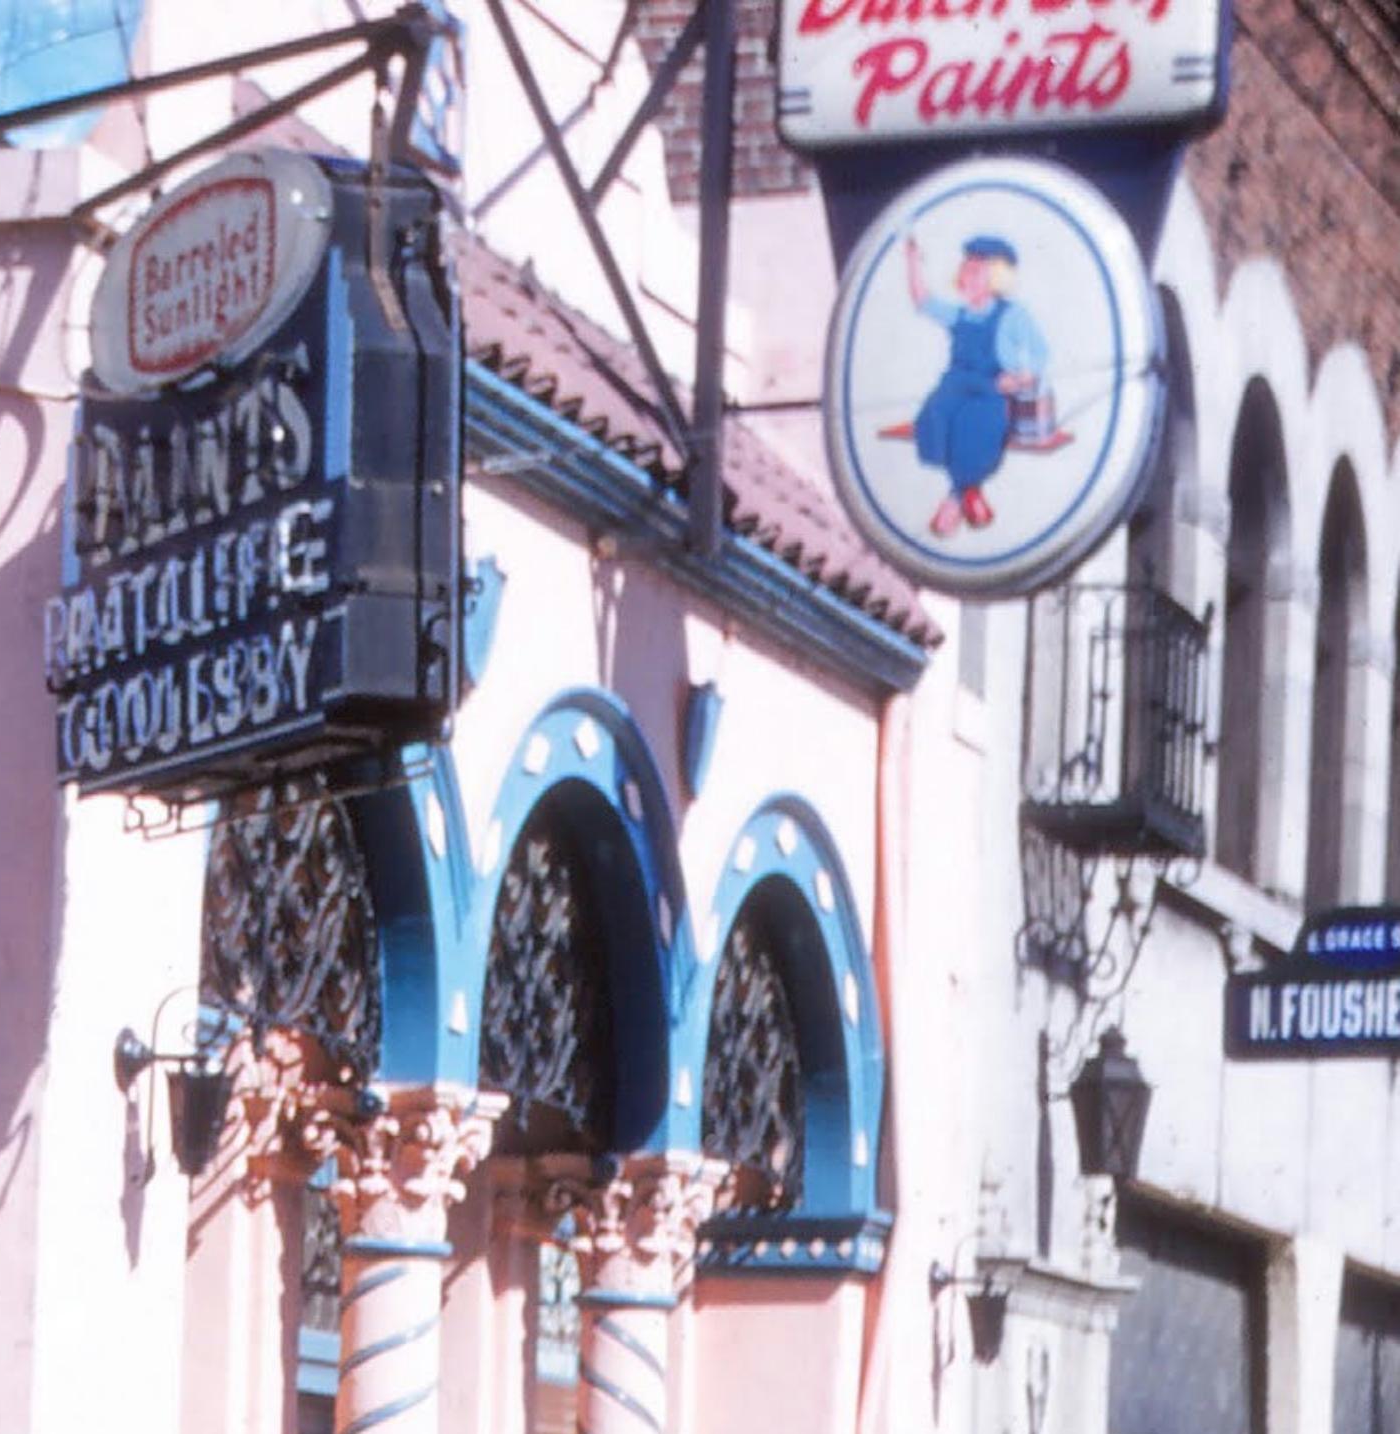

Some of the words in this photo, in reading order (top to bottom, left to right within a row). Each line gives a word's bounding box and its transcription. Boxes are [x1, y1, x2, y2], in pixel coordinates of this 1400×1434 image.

[852, 23, 1132, 128] Paints
[145, 211, 258, 297] Barreled
[144, 260, 258, 345] Sunlight
